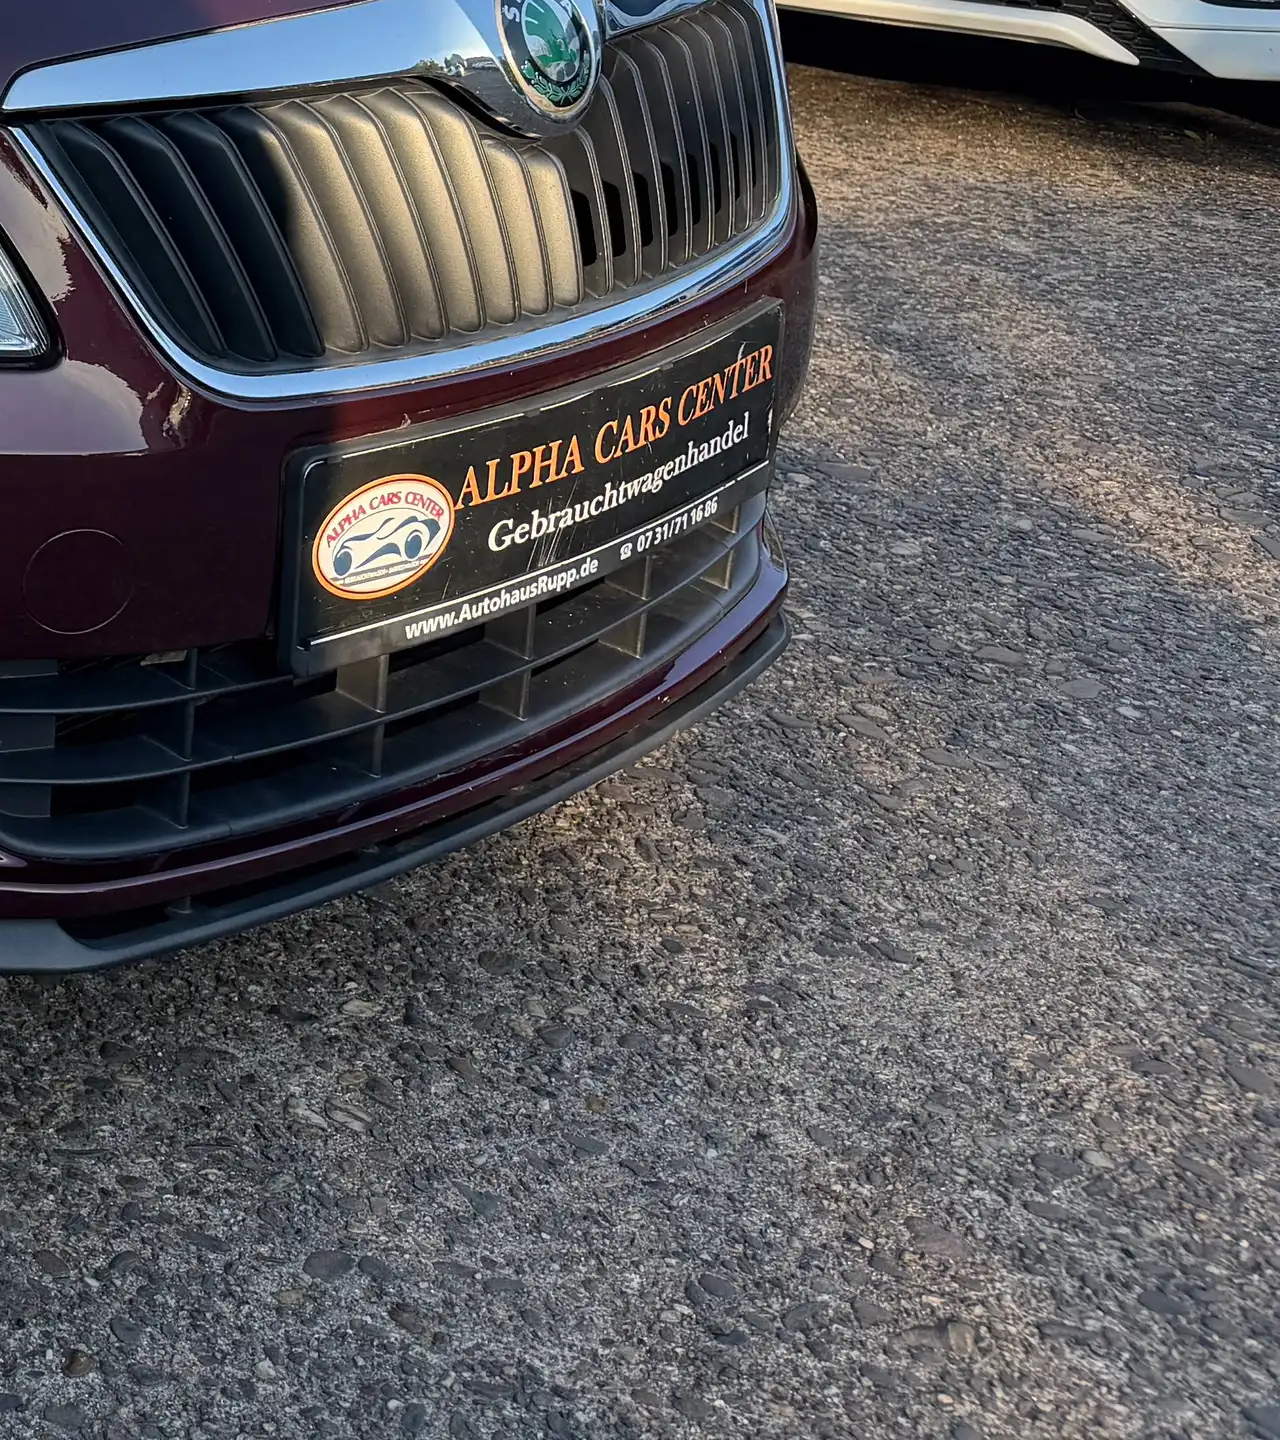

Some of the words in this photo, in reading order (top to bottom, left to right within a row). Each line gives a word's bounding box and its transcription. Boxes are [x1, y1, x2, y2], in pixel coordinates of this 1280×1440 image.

[454, 434, 585, 509] ALPHA
[594, 396, 673, 464] CARS
[678, 344, 774, 426] CENTER
[488, 411, 749, 552] Gebrauchtwagenhandel
[326, 504, 367, 548] ALPHA
[369, 491, 403, 510] CARS
[405, 491, 445, 521] CENTER
[405, 556, 599, 640] www.AutohausRupp.de
